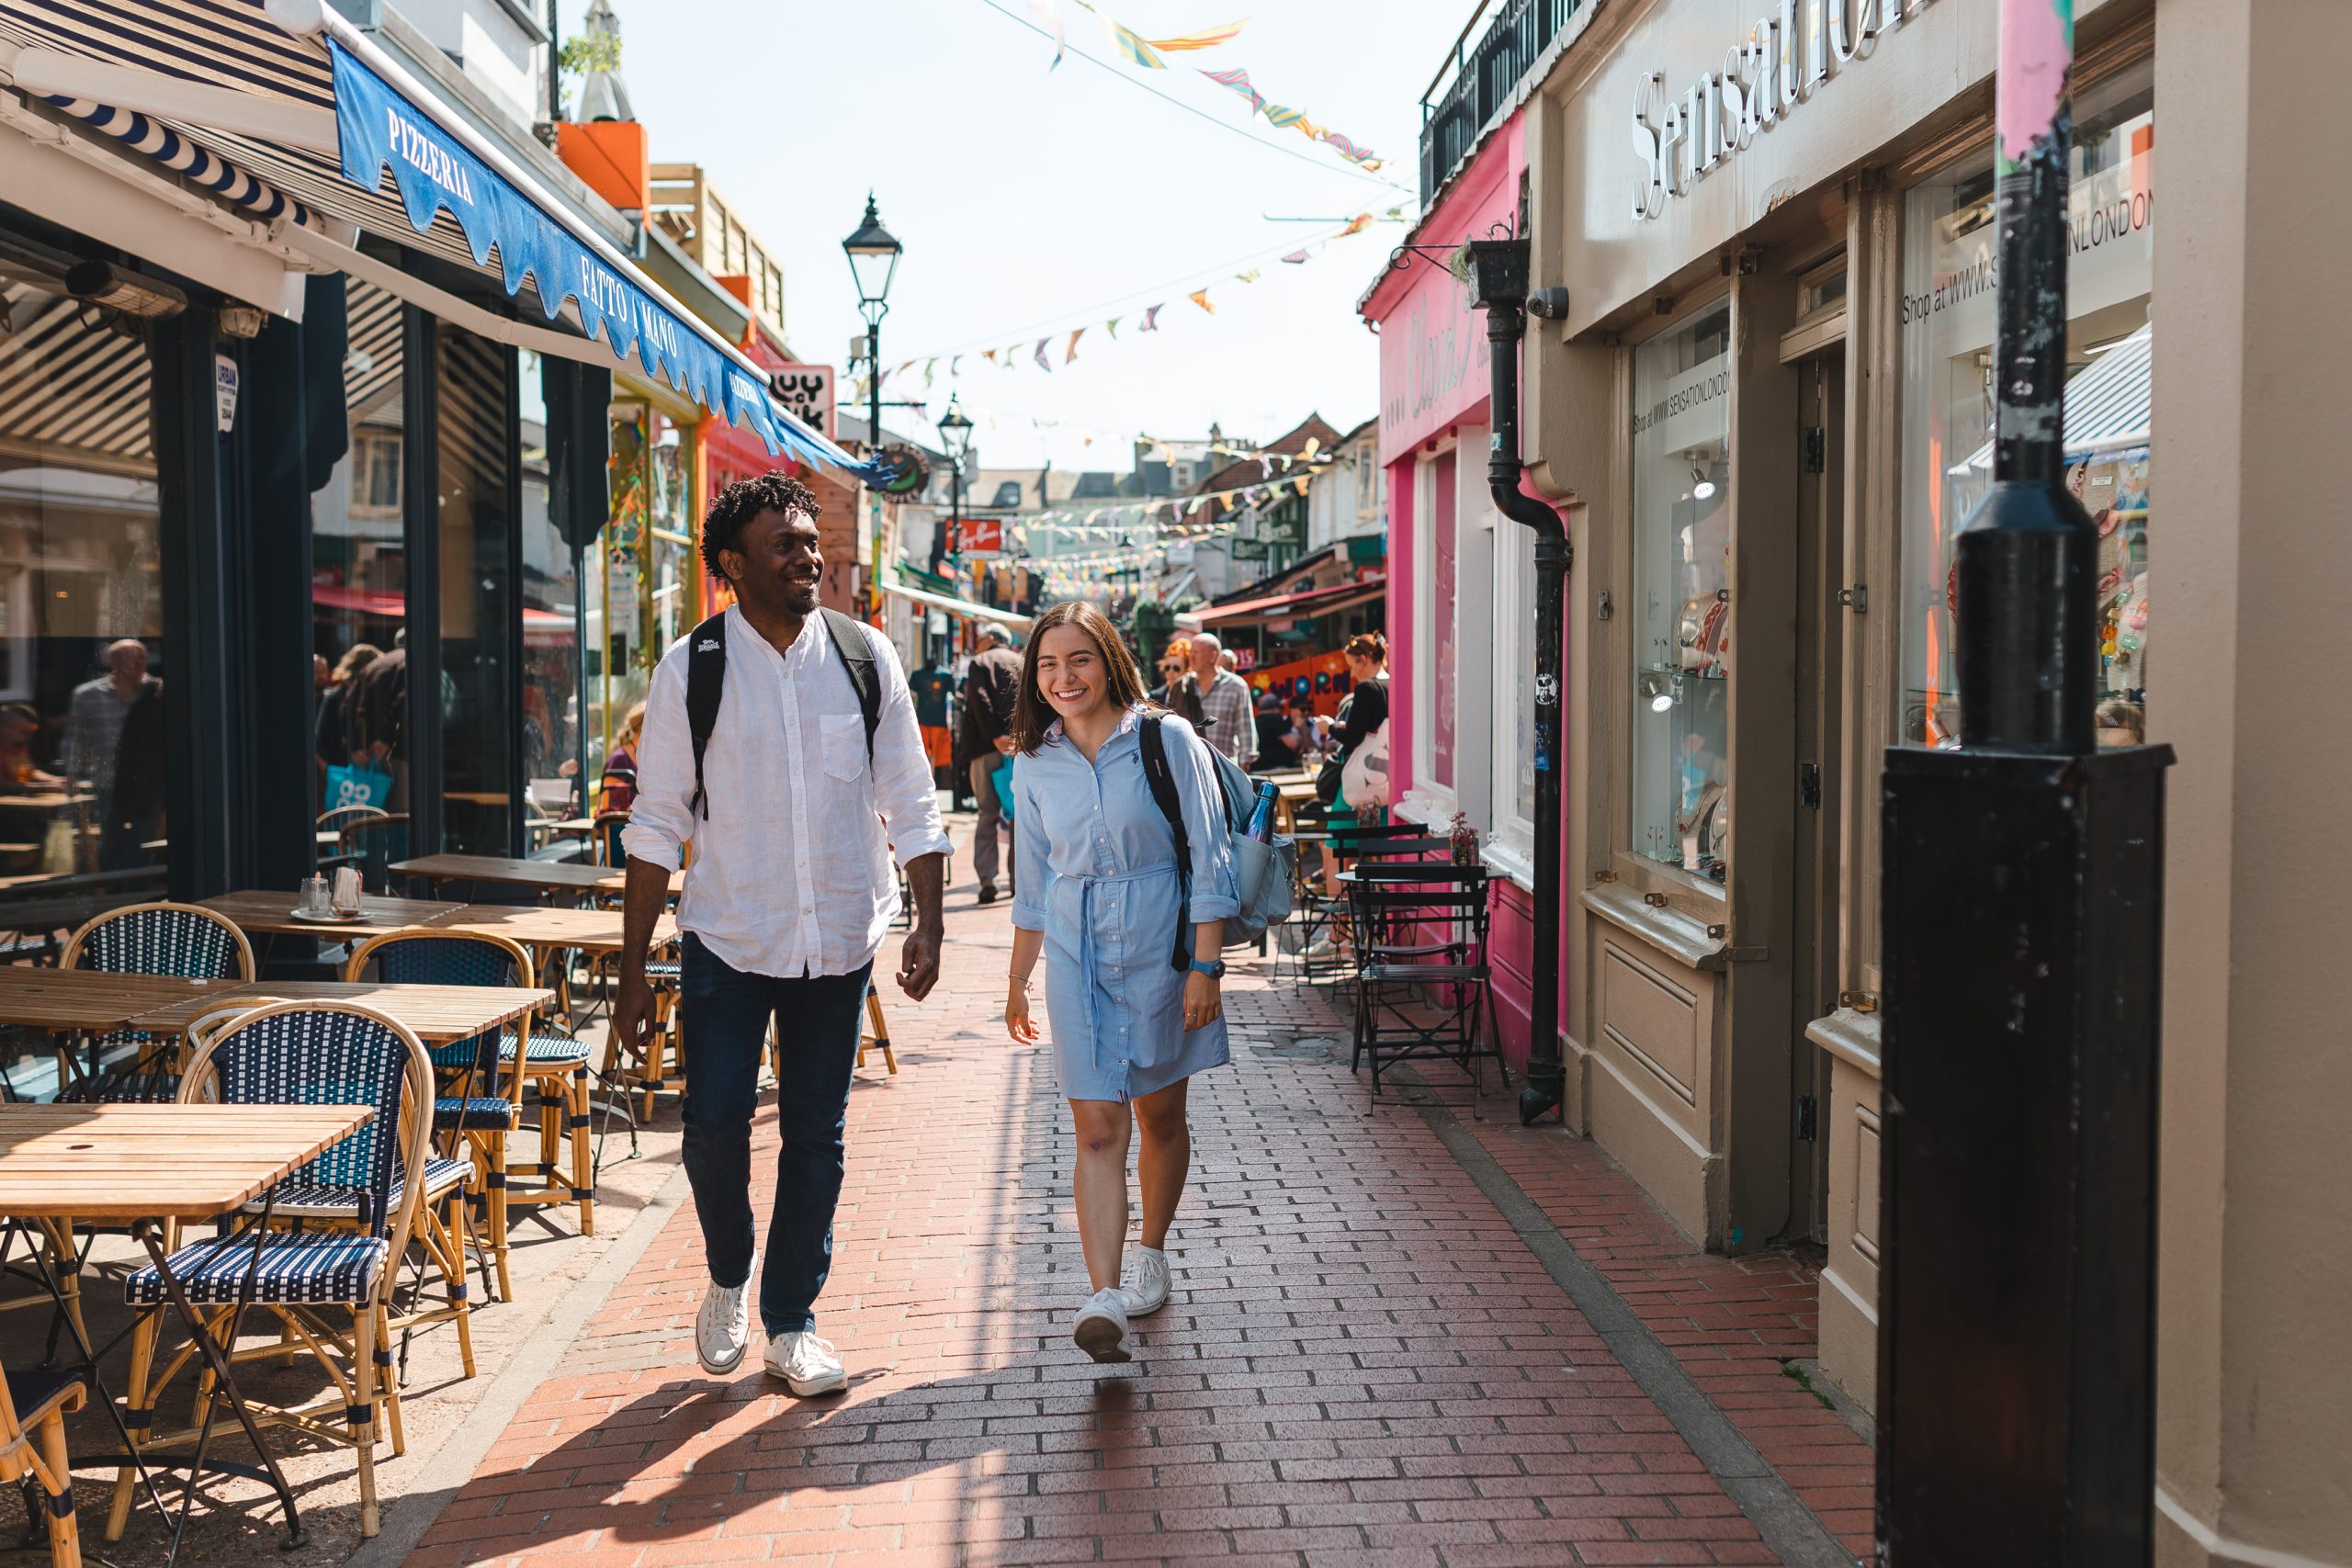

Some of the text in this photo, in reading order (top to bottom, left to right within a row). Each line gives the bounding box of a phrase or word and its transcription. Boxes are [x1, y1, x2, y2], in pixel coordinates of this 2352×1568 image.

[387, 107, 474, 207] PIZZERIA
[1631, 0, 1927, 224] Sensatio
[581, 254, 628, 323] FATTO
[641, 299, 677, 358] MANO
[1903, 293, 1930, 325] Shop
[1934, 282, 1946, 312] at
[1654, 369, 1731, 425] WWW.SENSATIONLONDO
